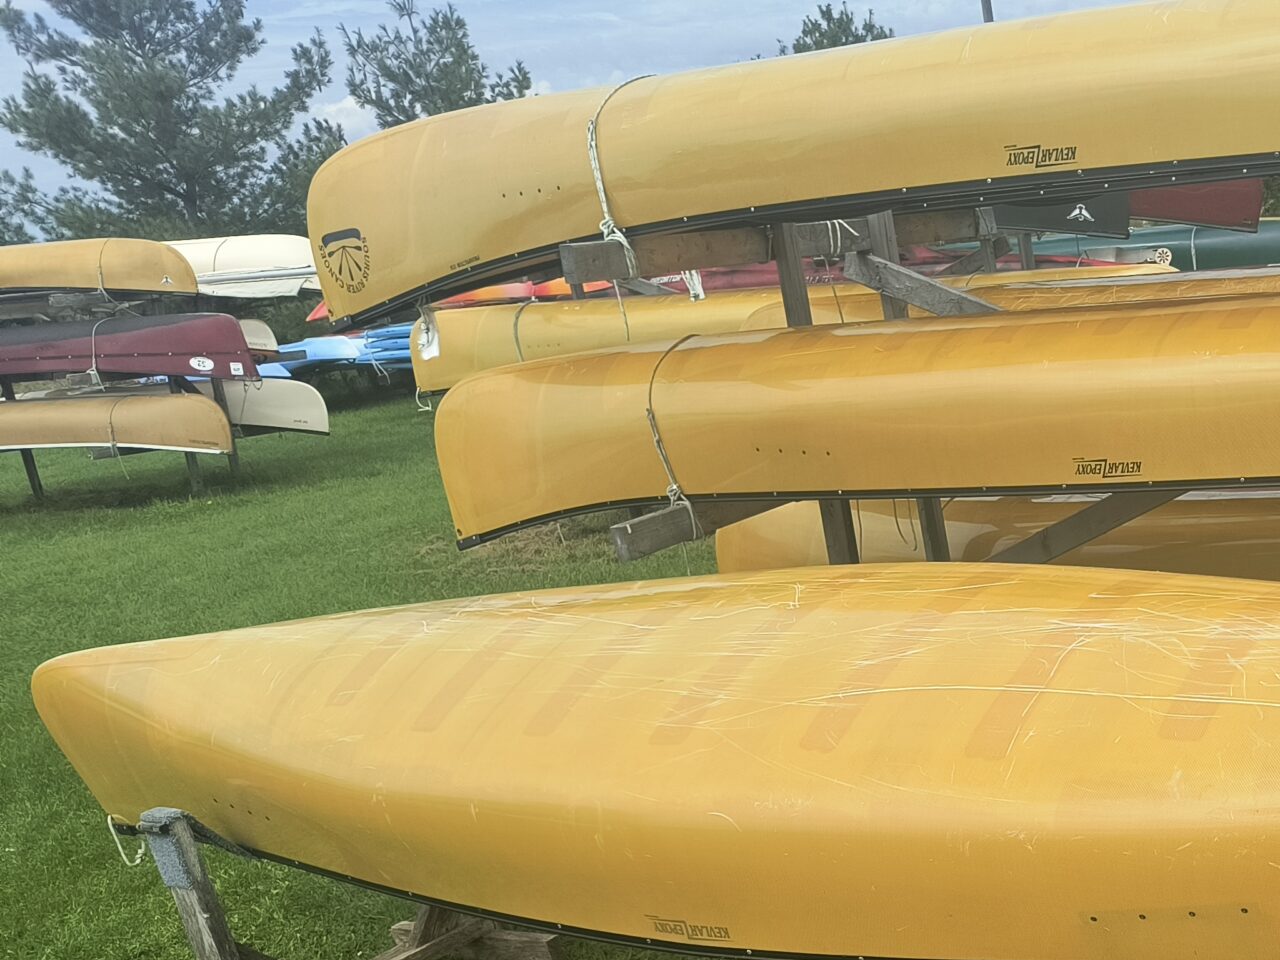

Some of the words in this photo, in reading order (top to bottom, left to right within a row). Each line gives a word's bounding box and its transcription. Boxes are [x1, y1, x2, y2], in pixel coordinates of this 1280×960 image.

[1006, 151, 1036, 167] EPOXY
[1040, 146, 1077, 163] KEVLAR
[1075, 463, 1103, 476] EPOXY
[1107, 461, 1142, 475] KEVLAR
[654, 921, 685, 936] EPOXY
[689, 924, 731, 940] KEVLAR
